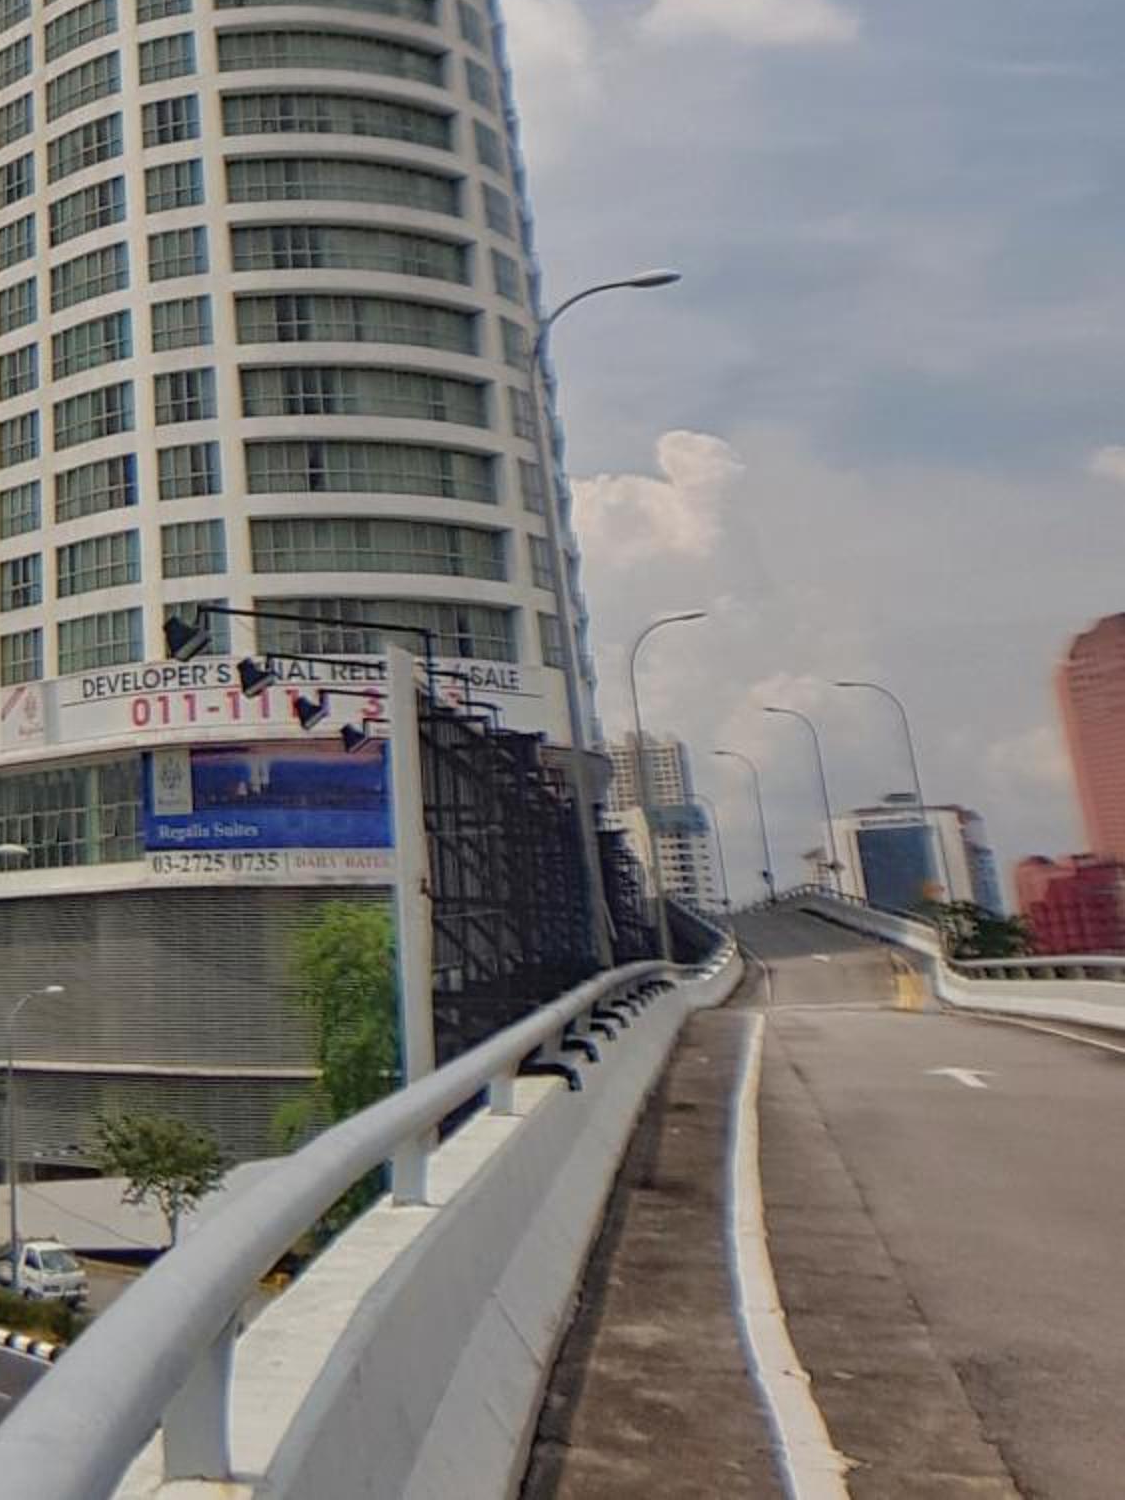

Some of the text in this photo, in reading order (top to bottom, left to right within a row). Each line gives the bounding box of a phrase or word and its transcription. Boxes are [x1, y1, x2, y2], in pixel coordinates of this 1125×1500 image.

[82, 663, 232, 698] DEVELOPER'S
[469, 665, 520, 690] SALE
[152, 853, 225, 875] 03-2725
[232, 851, 280, 872] 0735
